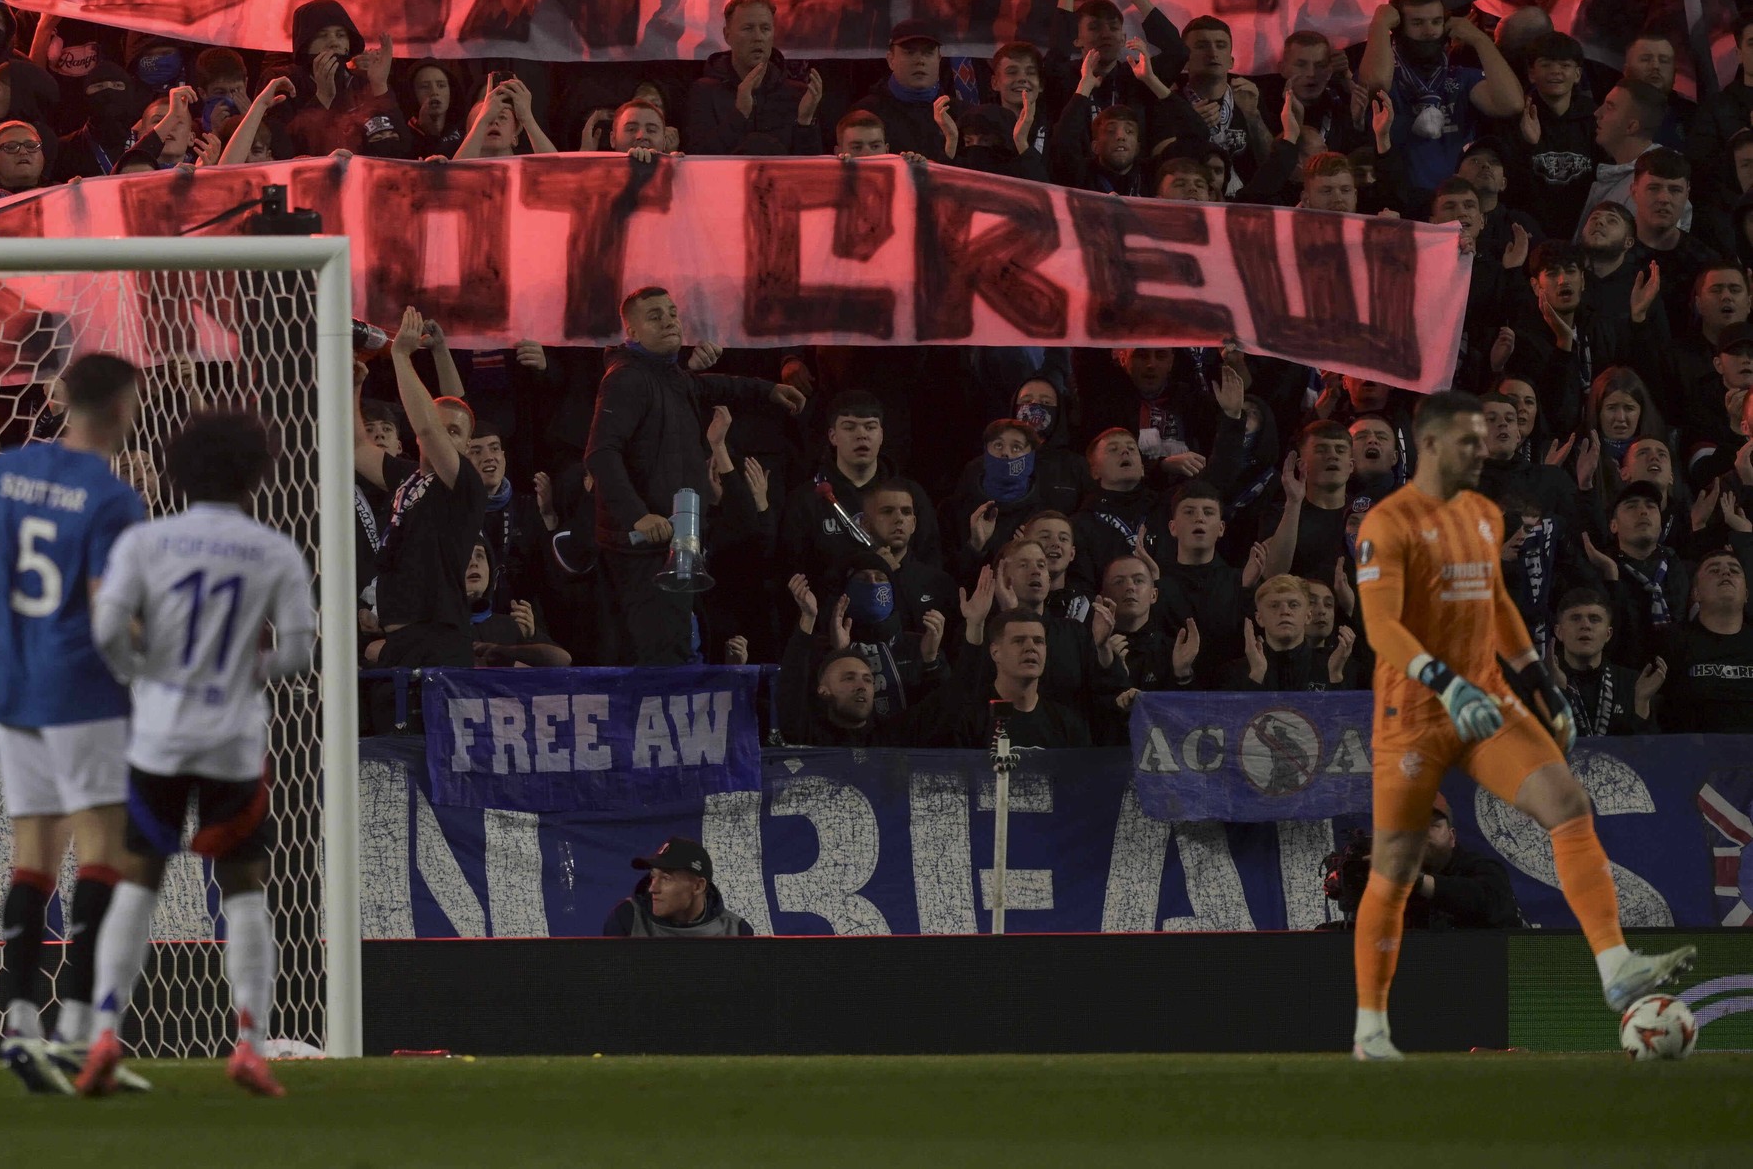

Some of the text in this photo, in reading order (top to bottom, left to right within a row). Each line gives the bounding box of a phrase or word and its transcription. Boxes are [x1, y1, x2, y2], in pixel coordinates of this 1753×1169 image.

[748, 159, 1422, 381] CREW
[11, 515, 62, 617] 5
[171, 568, 243, 672] 11
[449, 691, 733, 774] FREE AW
[1139, 726, 1227, 773] AC
